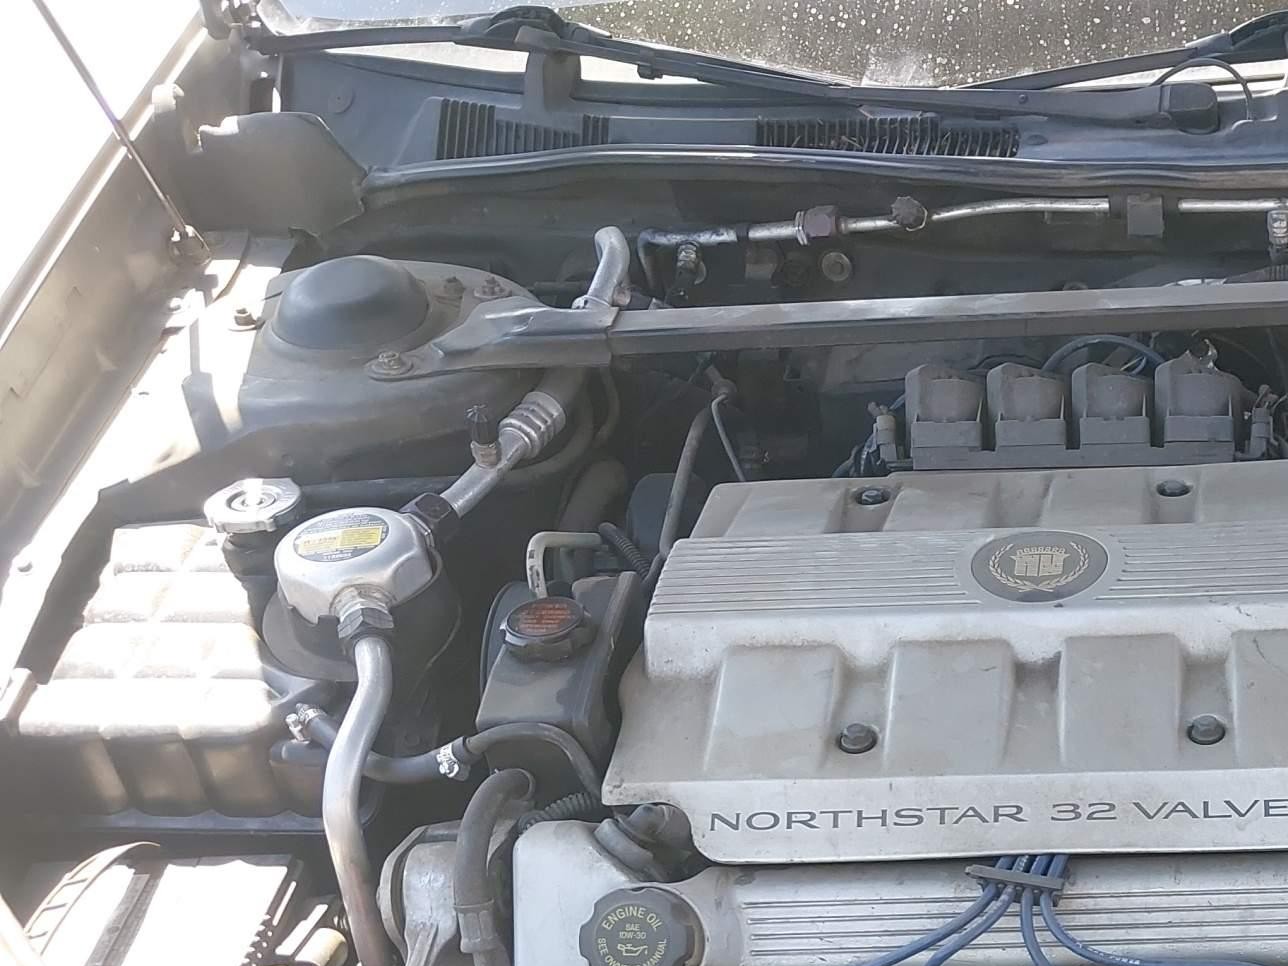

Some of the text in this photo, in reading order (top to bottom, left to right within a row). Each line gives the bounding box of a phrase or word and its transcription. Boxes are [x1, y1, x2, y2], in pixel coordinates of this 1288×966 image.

[709, 804, 1029, 832] NORTHSTAR
[1049, 802, 1118, 822] 32
[602, 906, 662, 931] ENGINE OIL
[625, 923, 640, 931] SAE
[598, 938, 609, 956] SEE
